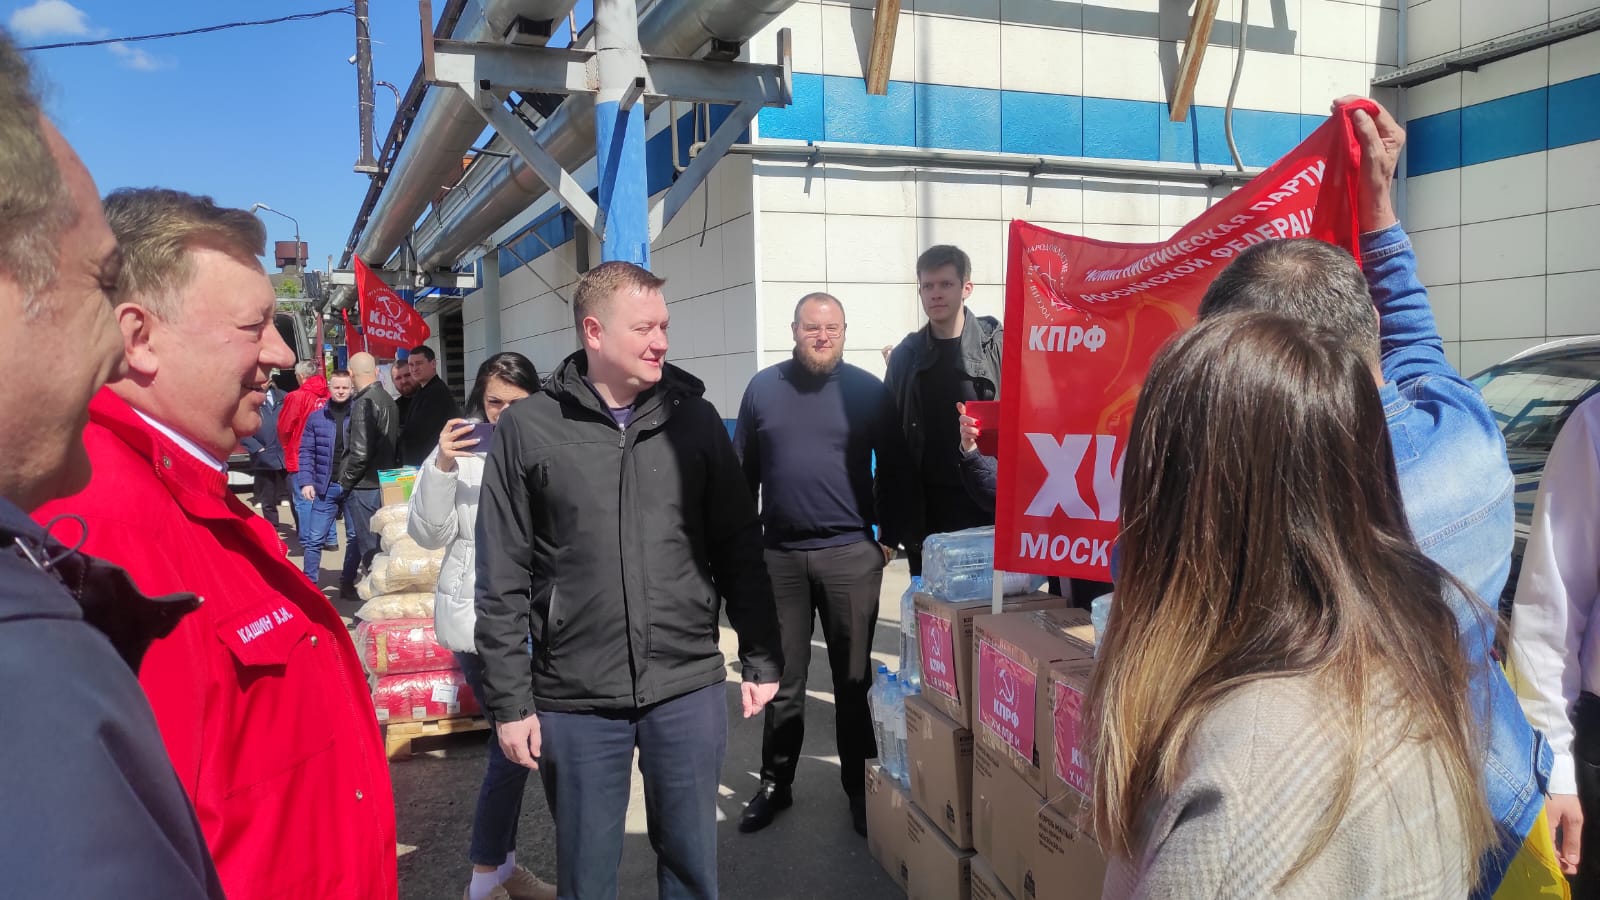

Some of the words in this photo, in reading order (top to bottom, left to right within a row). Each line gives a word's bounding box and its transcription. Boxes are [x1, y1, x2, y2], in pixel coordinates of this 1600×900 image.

[1249, 159, 1327, 212] ПАРТИ
[1210, 206, 1317, 258] ФЕДЕРАЦ
[1028, 324, 1107, 352] КПРФ
[1023, 432, 1130, 522] ХИ
[1019, 532, 1110, 567] МОСК
[236, 614, 274, 644] КАШИН
[993, 697, 1020, 729] КПРФ
